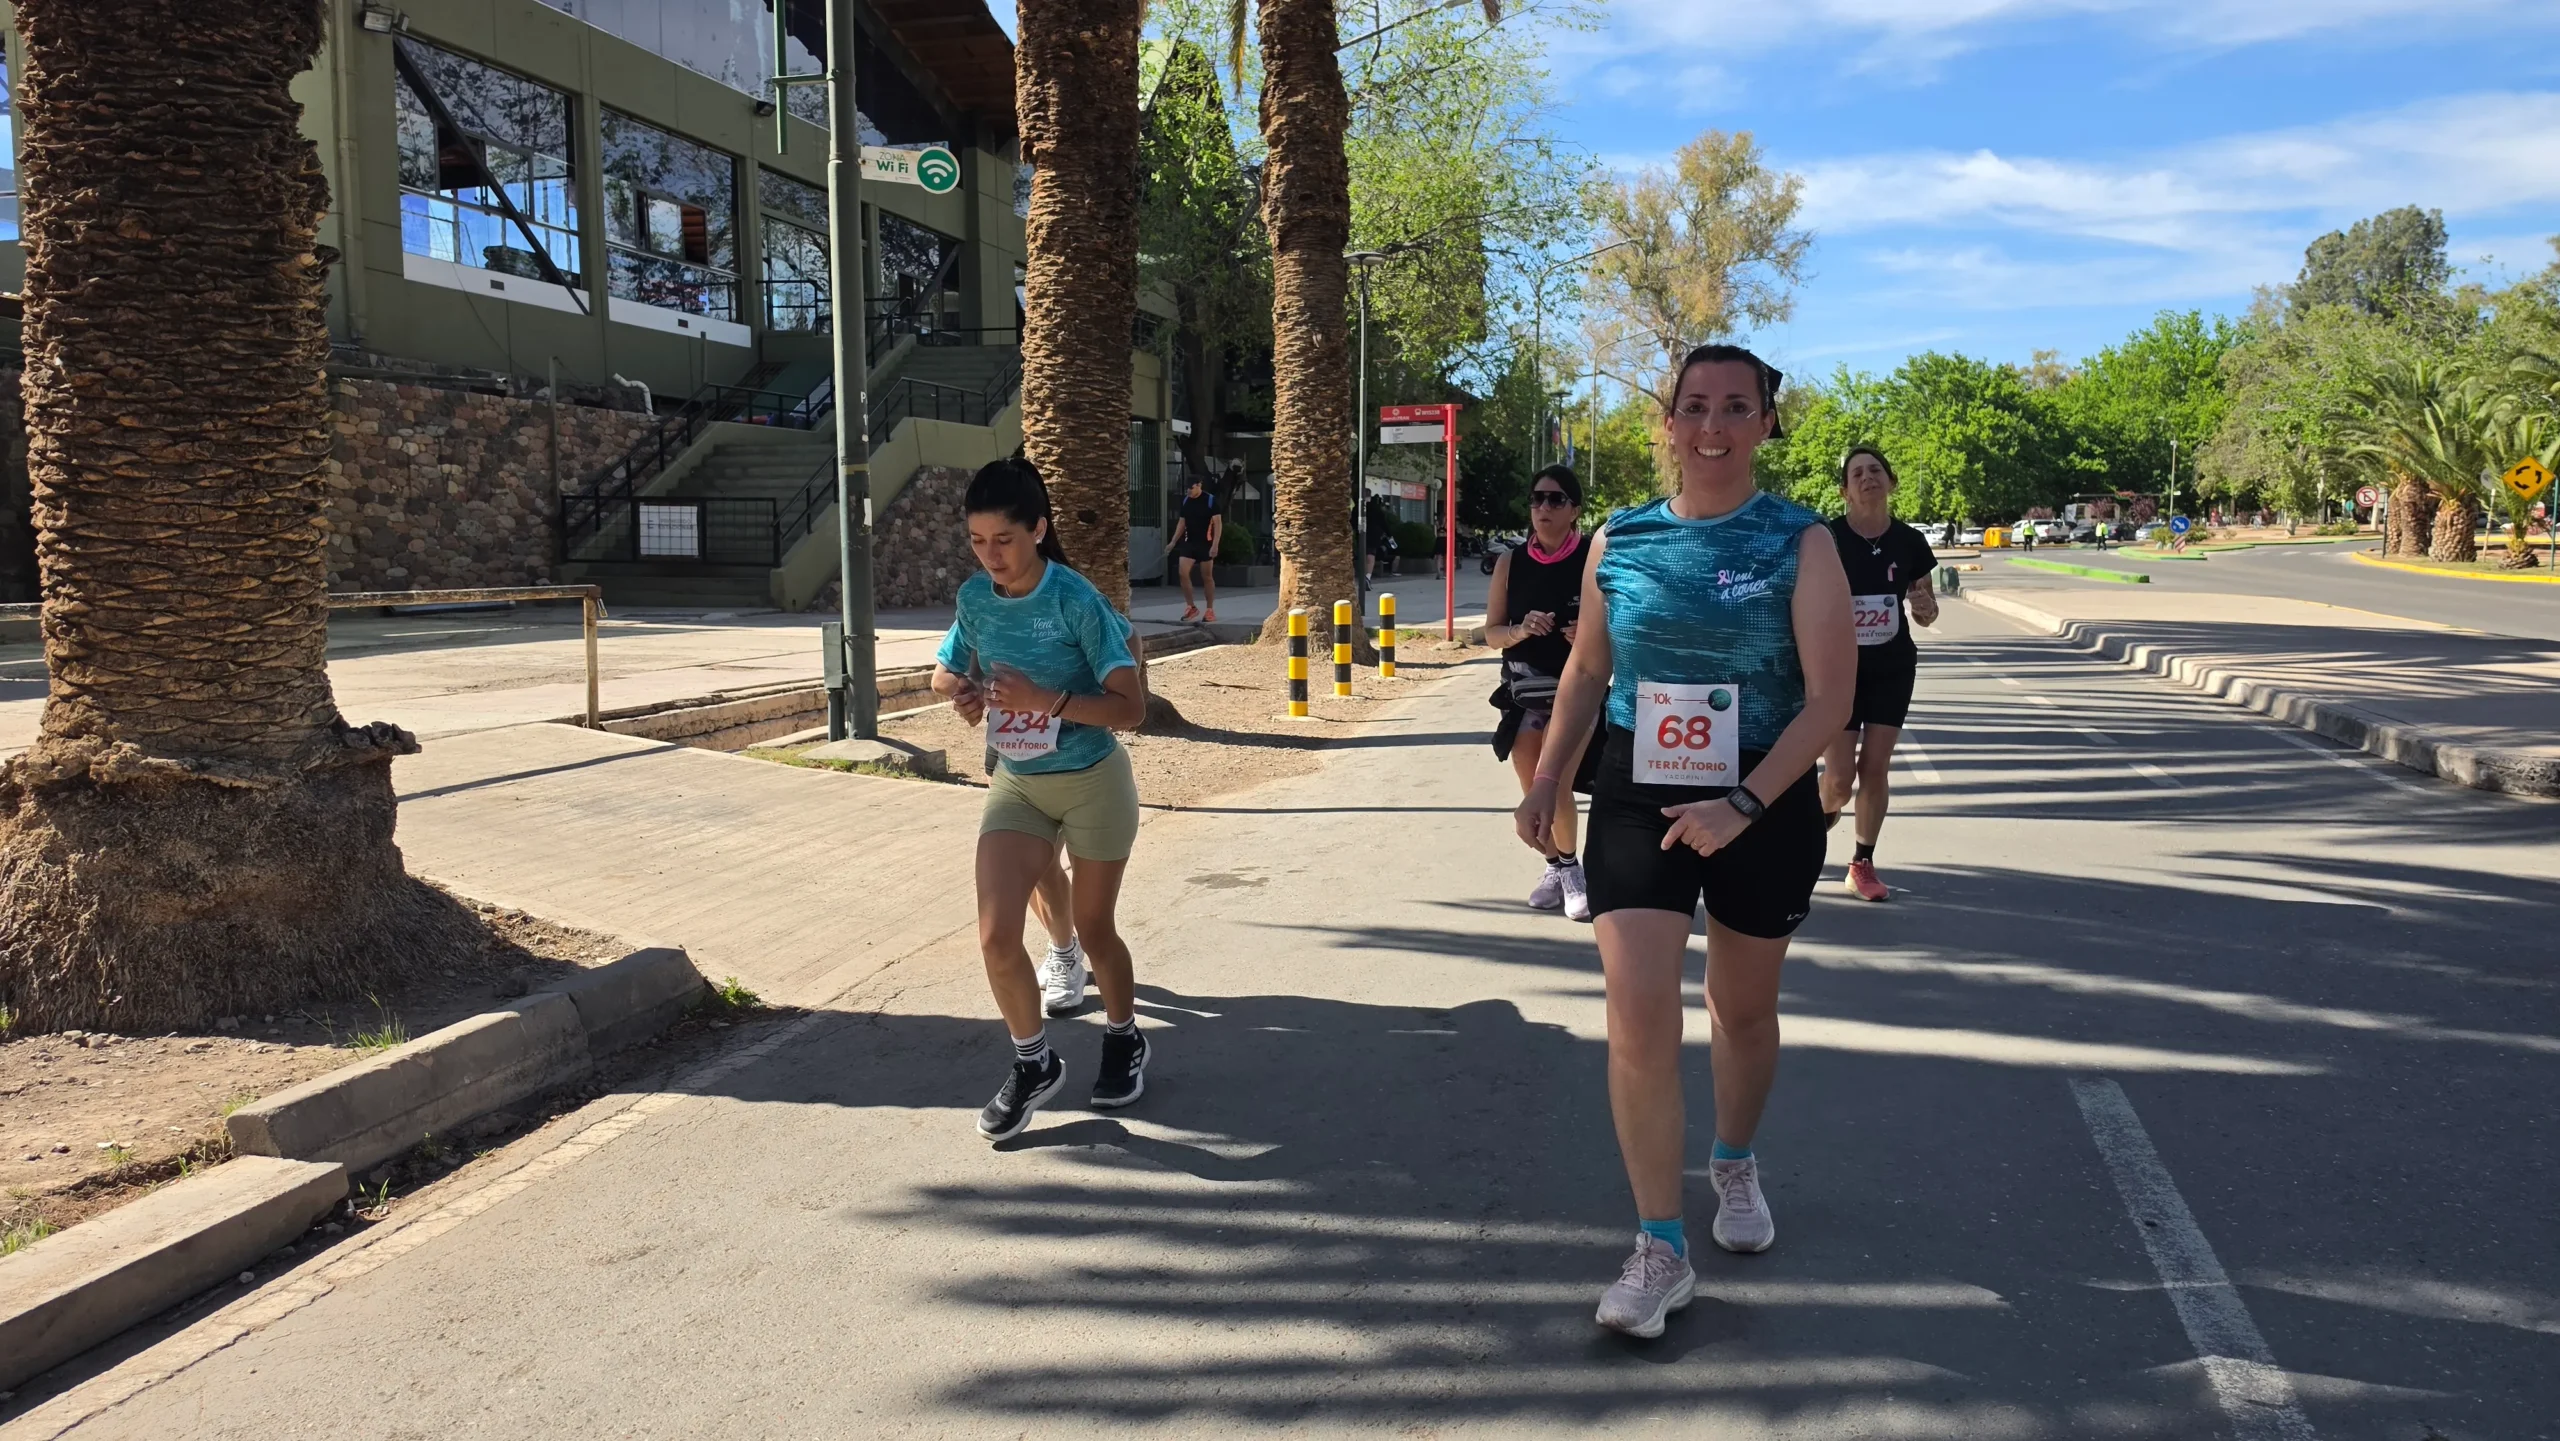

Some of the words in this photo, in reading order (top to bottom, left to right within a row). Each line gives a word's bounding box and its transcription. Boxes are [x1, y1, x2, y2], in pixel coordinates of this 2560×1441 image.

[879, 152, 907, 162] ZONA
[876, 160, 895, 173] Wi
[898, 162, 909, 174] Fi
[1720, 587, 1730, 600] a
[1854, 609, 1891, 628] 224
[1653, 693, 1672, 706] 10k
[995, 710, 1050, 734] 234
[1657, 714, 1713, 751] 68
[1664, 773, 1705, 781] YACOPINI
